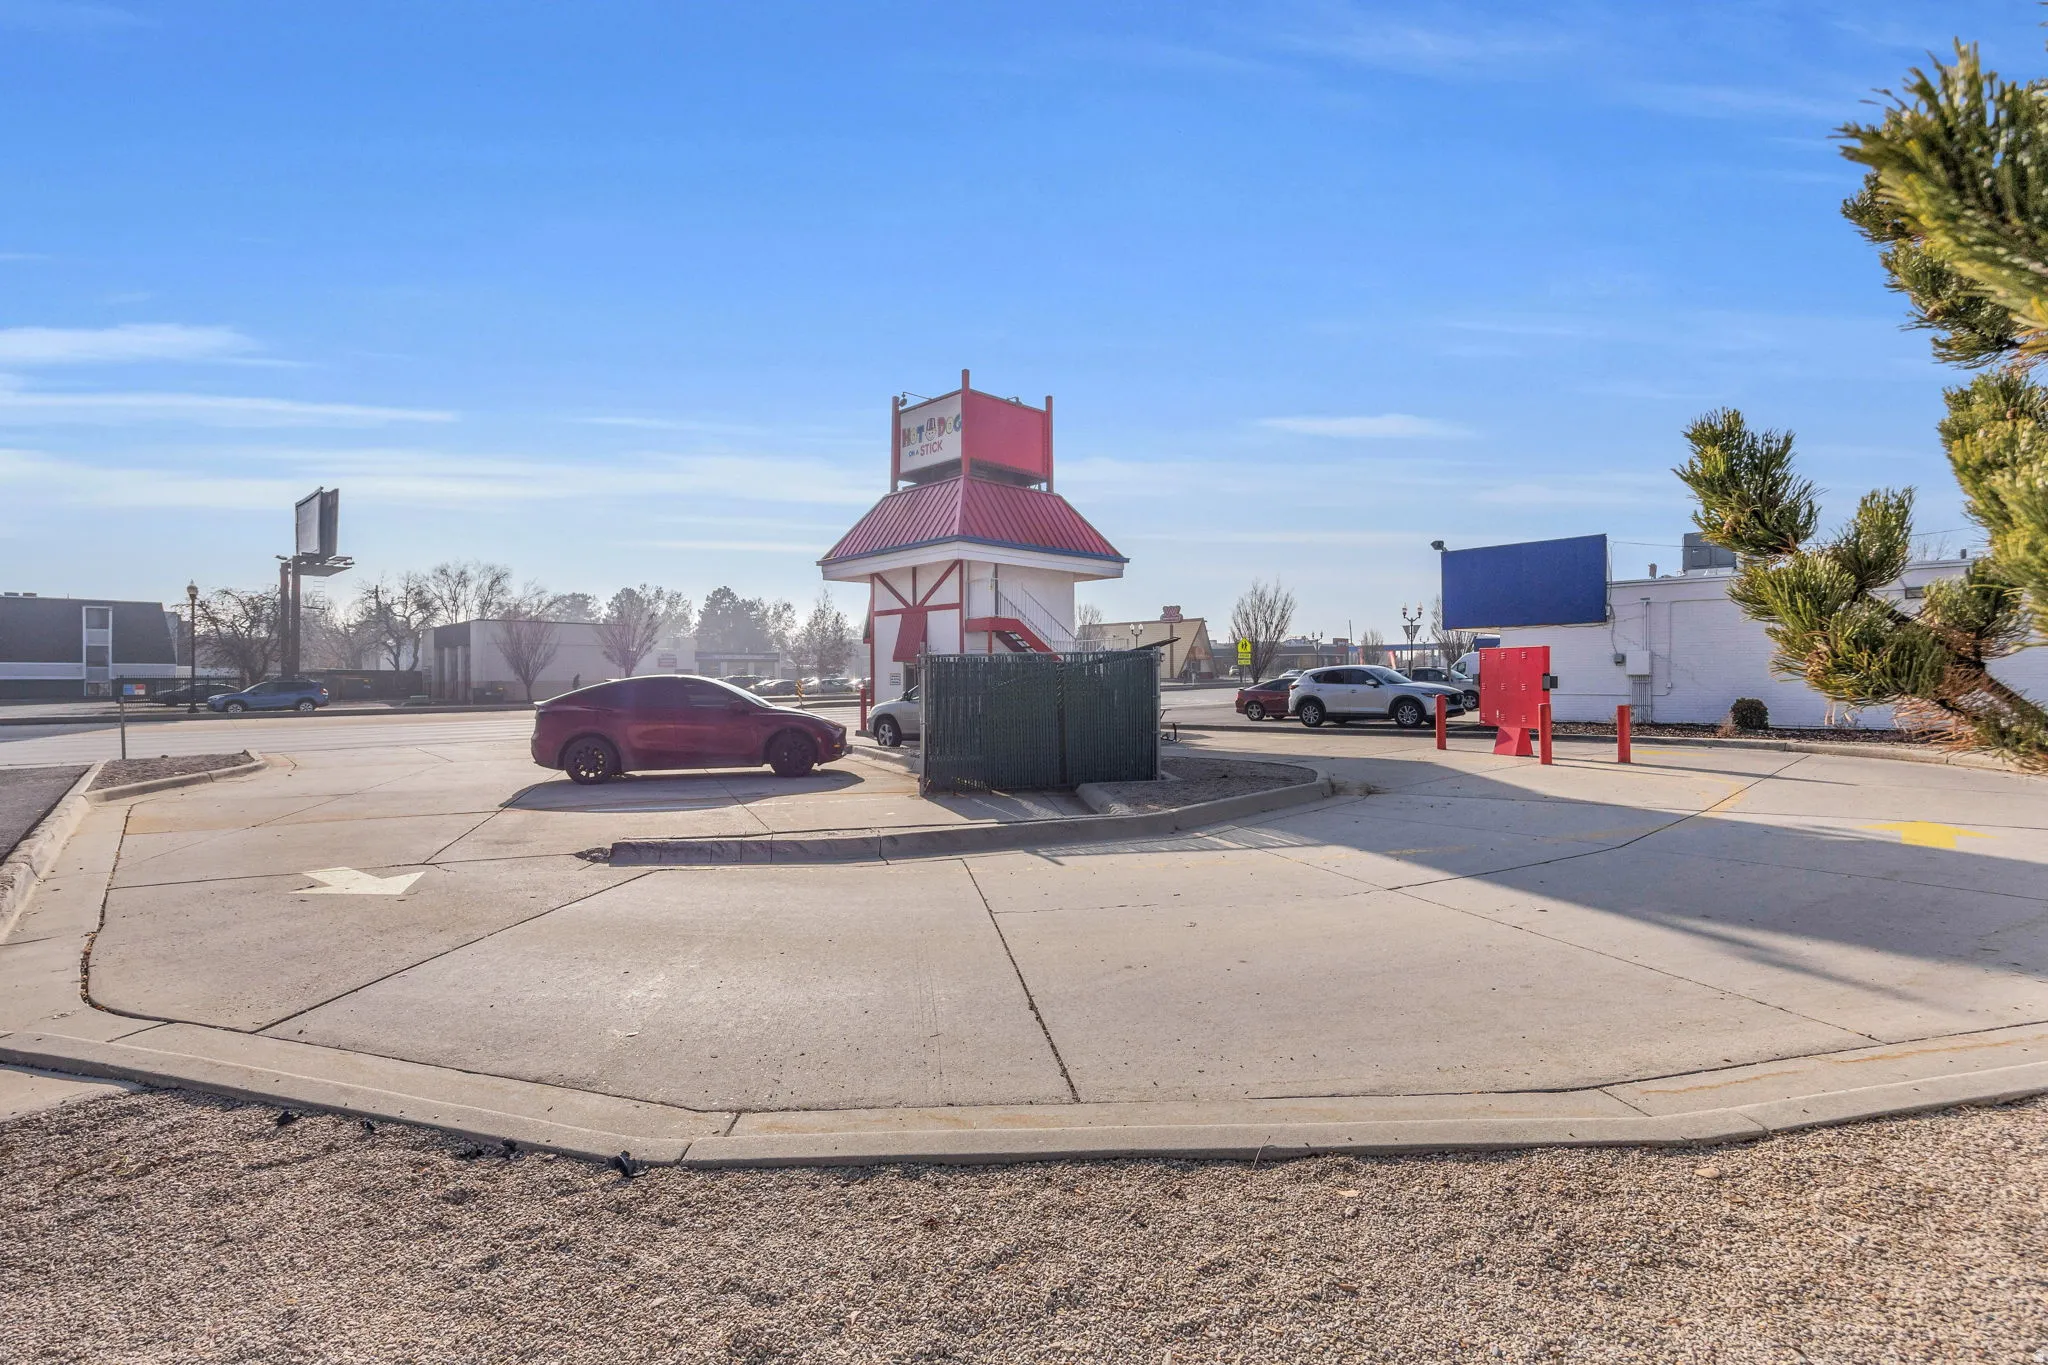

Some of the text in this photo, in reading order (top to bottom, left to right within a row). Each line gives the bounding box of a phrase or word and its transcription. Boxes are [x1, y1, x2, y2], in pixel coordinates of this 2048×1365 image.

[902, 414, 962, 448] HOT DOG
[920, 440, 943, 456] STICK
